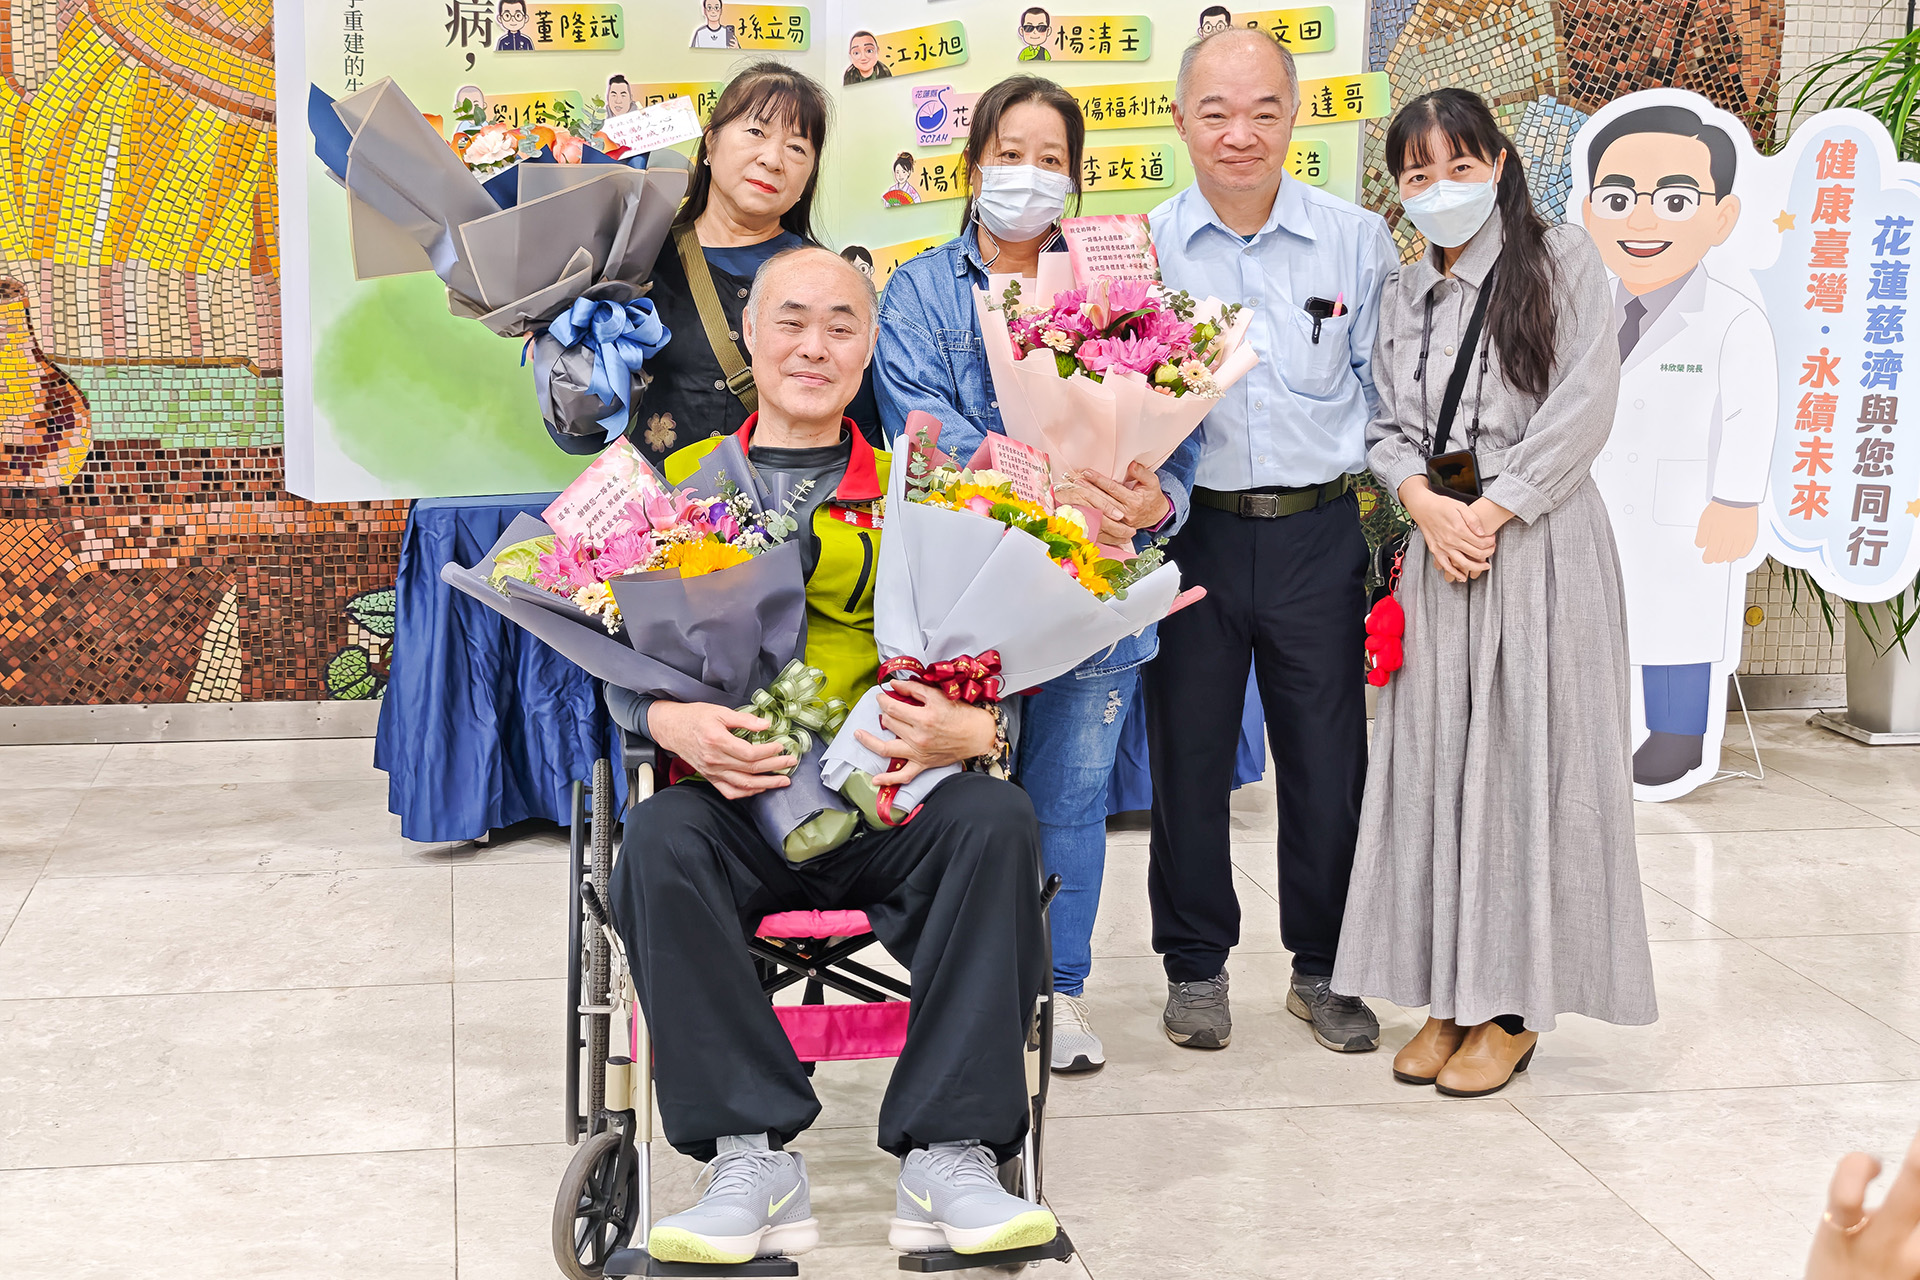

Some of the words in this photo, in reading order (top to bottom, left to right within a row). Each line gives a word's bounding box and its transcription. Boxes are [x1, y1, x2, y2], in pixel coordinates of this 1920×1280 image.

[535, 11, 619, 43] 董隆斌
[738, 14, 804, 43] 孫立易
[885, 36, 963, 67] 江永旭
[1075, 94, 1171, 121] 傷福利協
[1311, 83, 1364, 117] 達哥
[920, 165, 966, 192] 楊
[1084, 152, 1164, 186] 李政道
[1686, 364, 1703, 373] 院長
[1847, 215, 1914, 567] 花蓮慈濟與您同行
